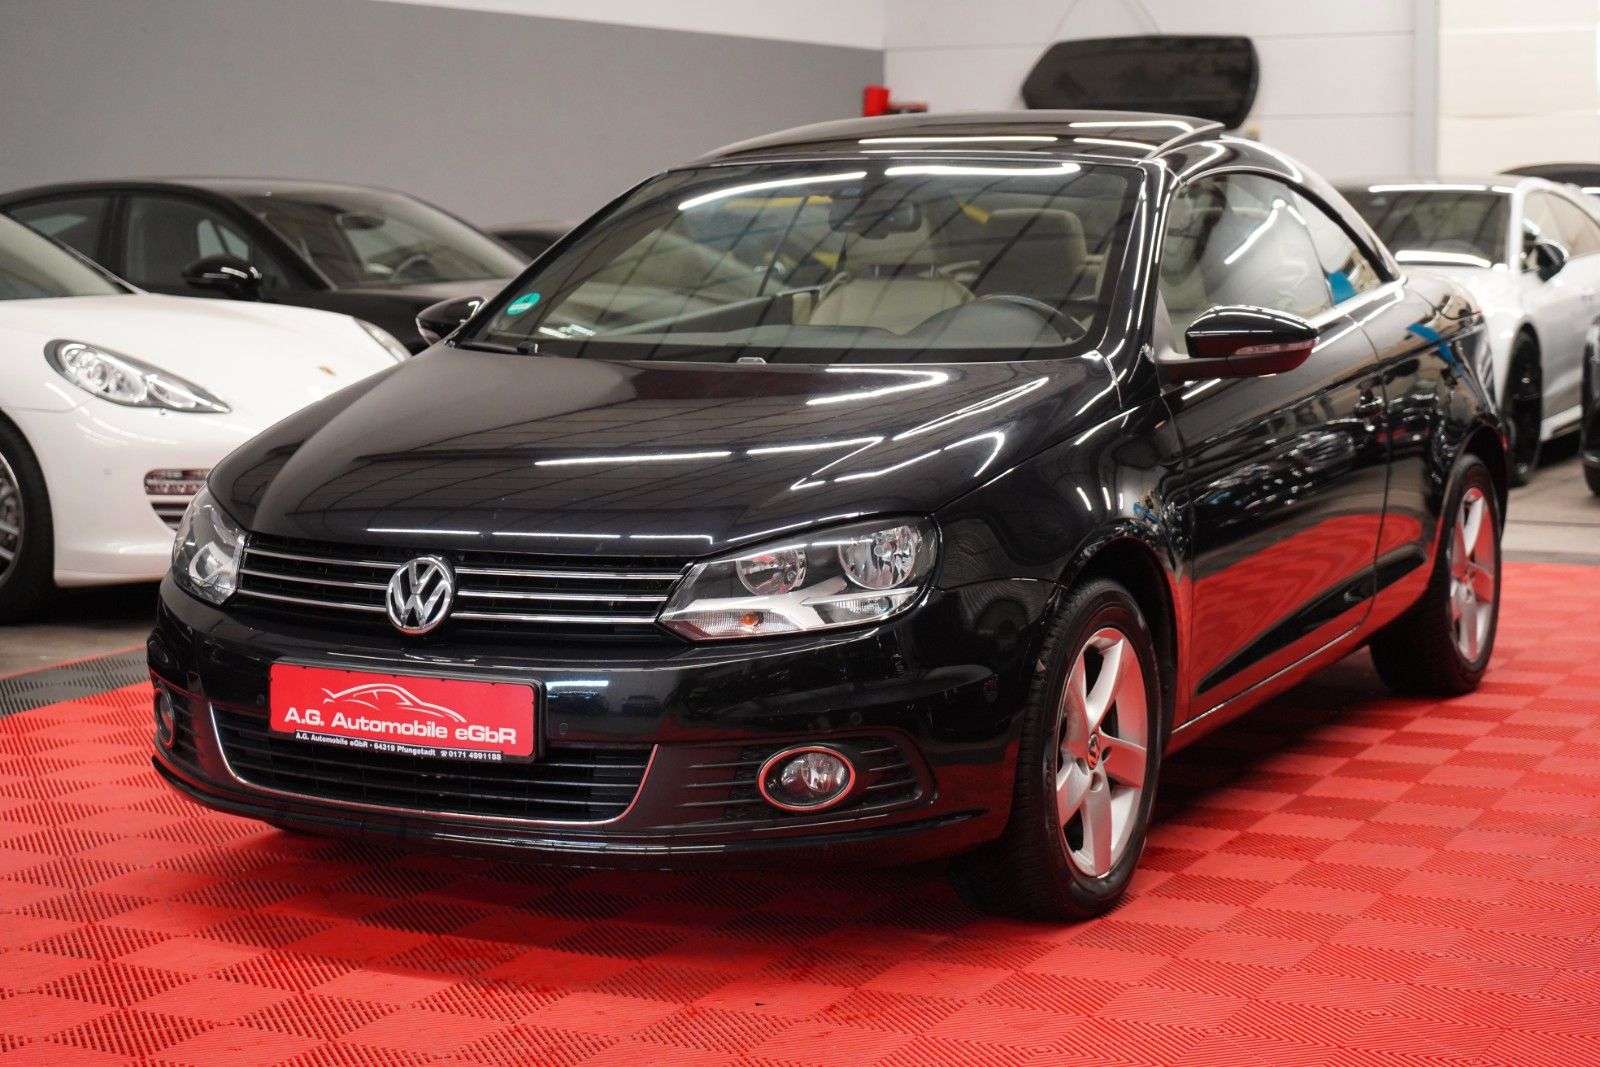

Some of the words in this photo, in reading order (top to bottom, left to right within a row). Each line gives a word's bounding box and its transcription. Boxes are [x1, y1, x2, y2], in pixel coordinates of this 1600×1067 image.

[386, 557, 452, 634] VW
[284, 706, 325, 726] A.G.
[331, 711, 448, 739] Automobile
[455, 724, 517, 745] eGbR
[295, 732, 310, 741] A.G.
[310, 734, 348, 746] Automobile
[349, 740, 368, 749] eGbR
[373, 742, 396, 752] 64319
[397, 745, 436, 757] Pfungstadt
[448, 750, 467, 758] 0171
